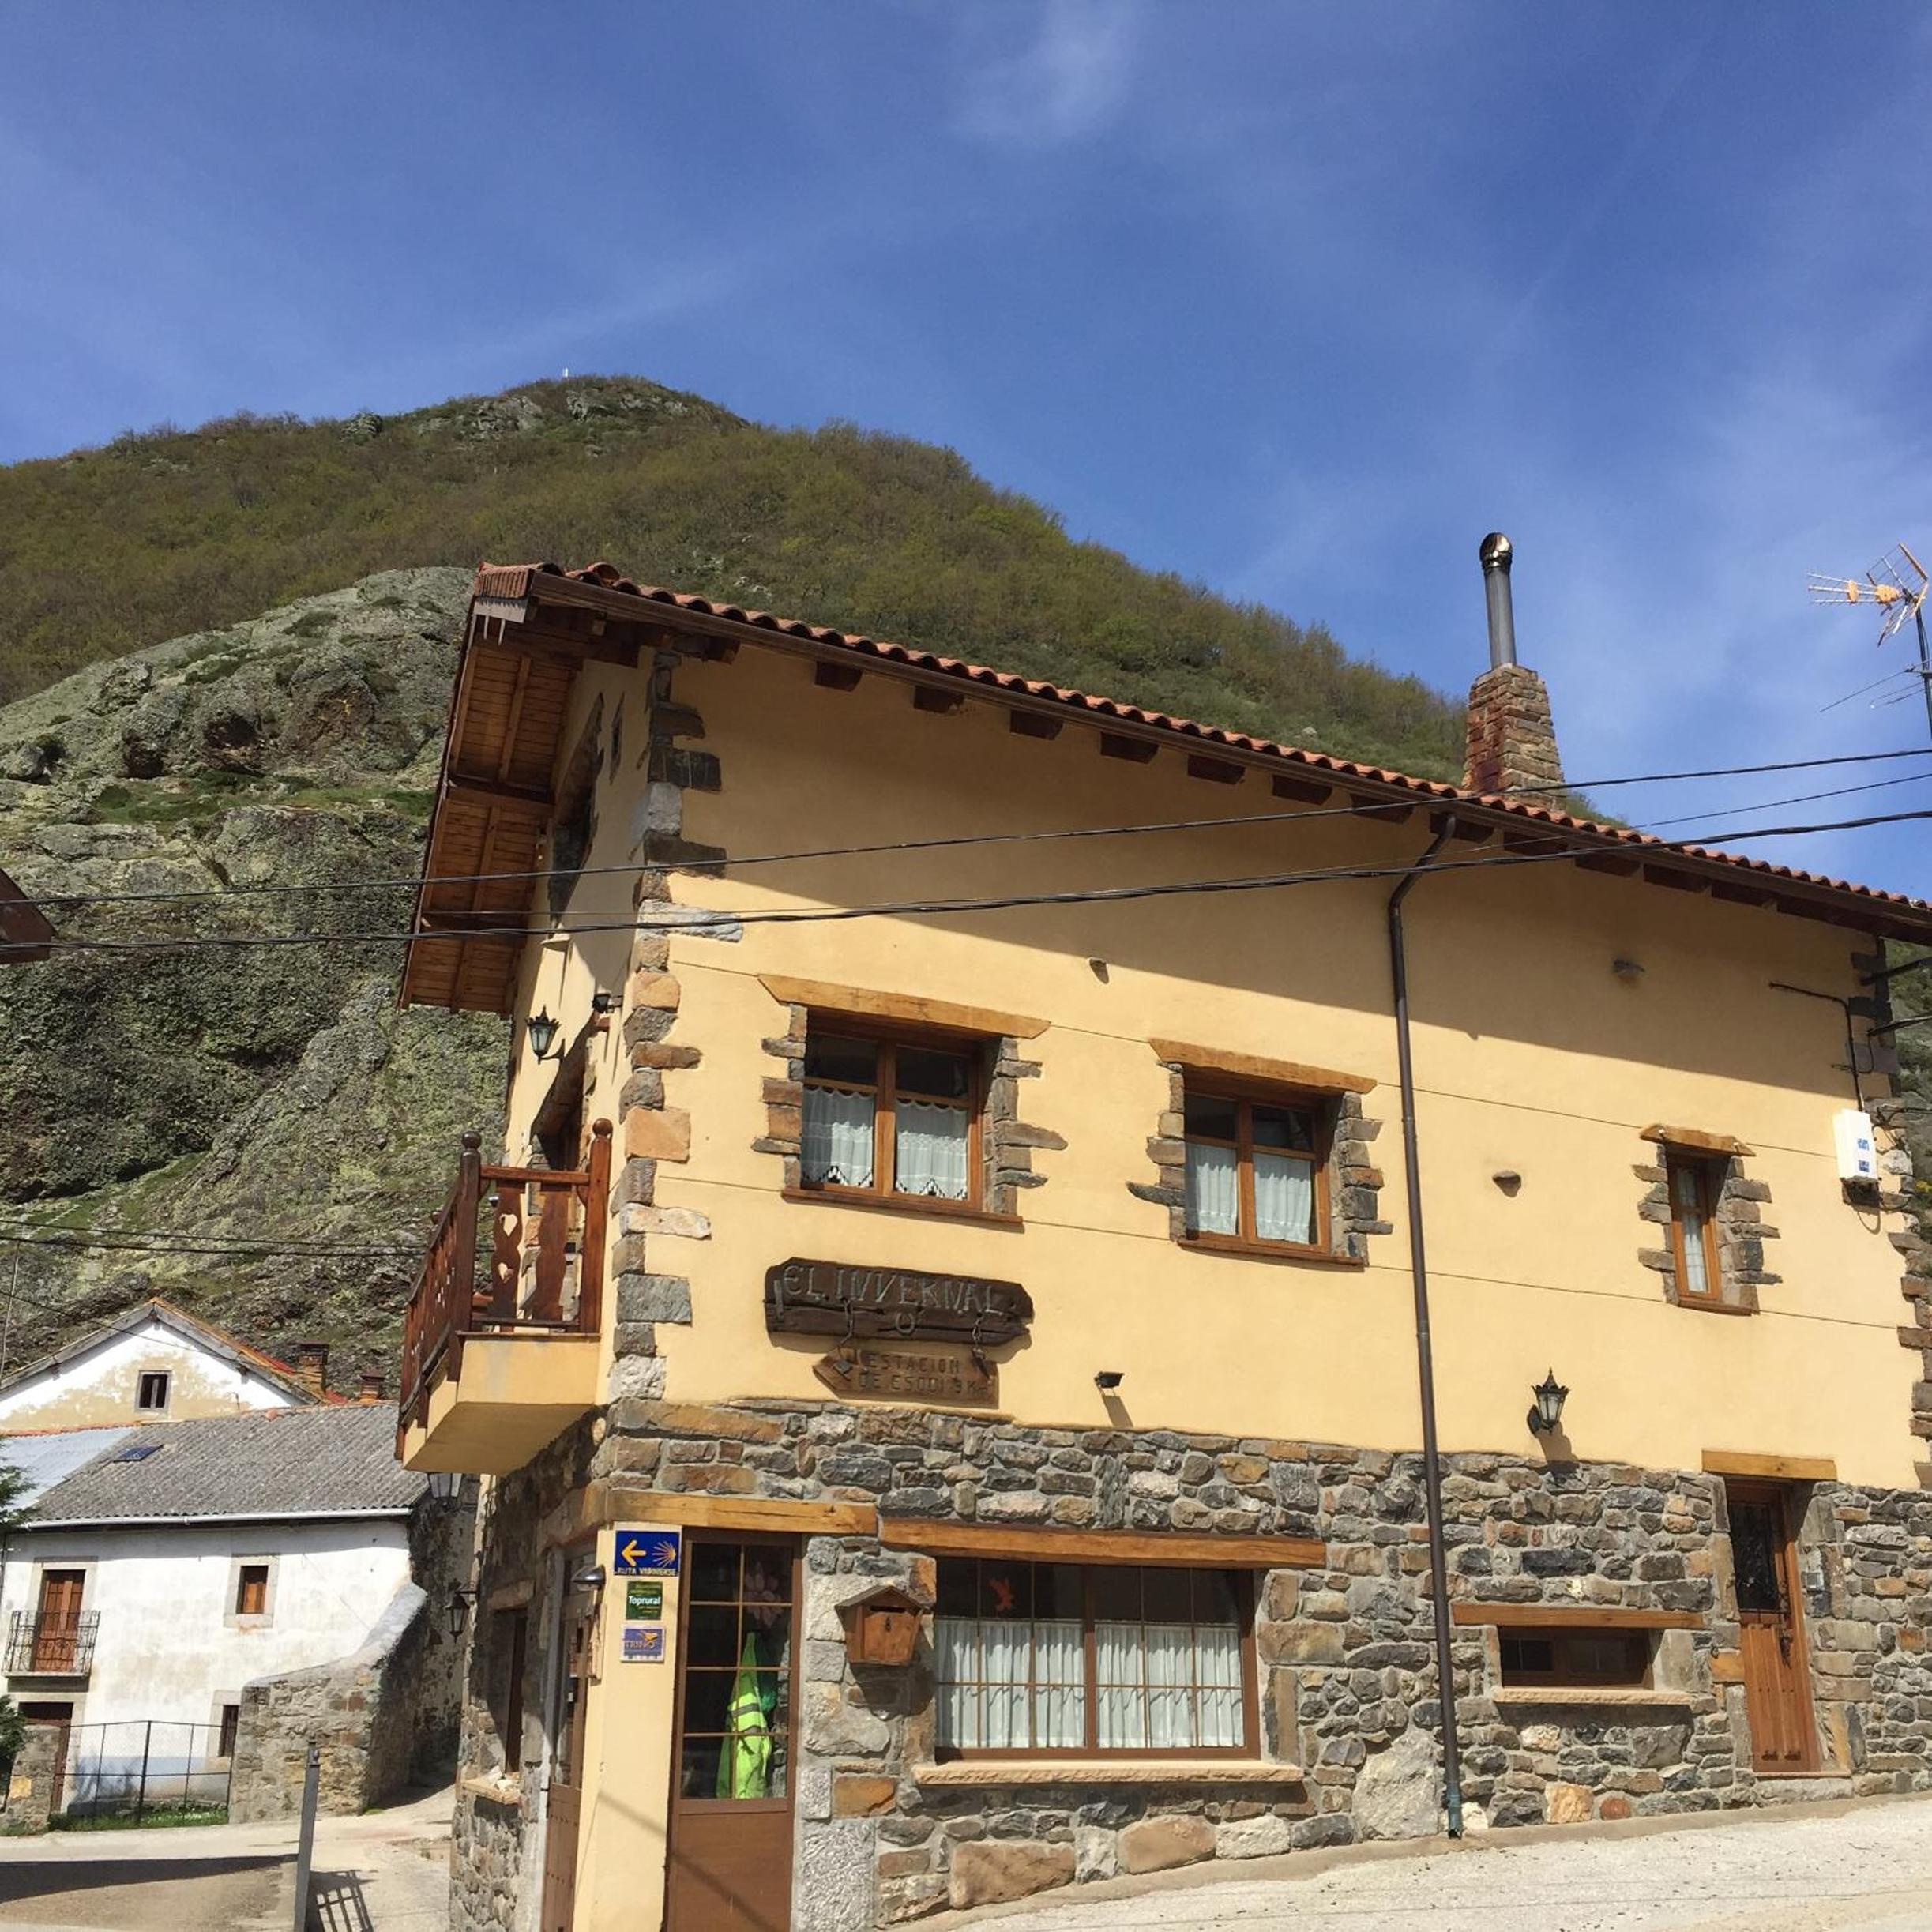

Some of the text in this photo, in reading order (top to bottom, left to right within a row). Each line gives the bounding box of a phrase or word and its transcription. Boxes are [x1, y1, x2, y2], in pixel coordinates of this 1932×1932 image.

[783, 1265, 1004, 1317] EL INVERNAL
[866, 1351, 960, 1375] ESTACION
[859, 1372, 881, 1390] DE
[628, 1596, 661, 1607] Toprural
